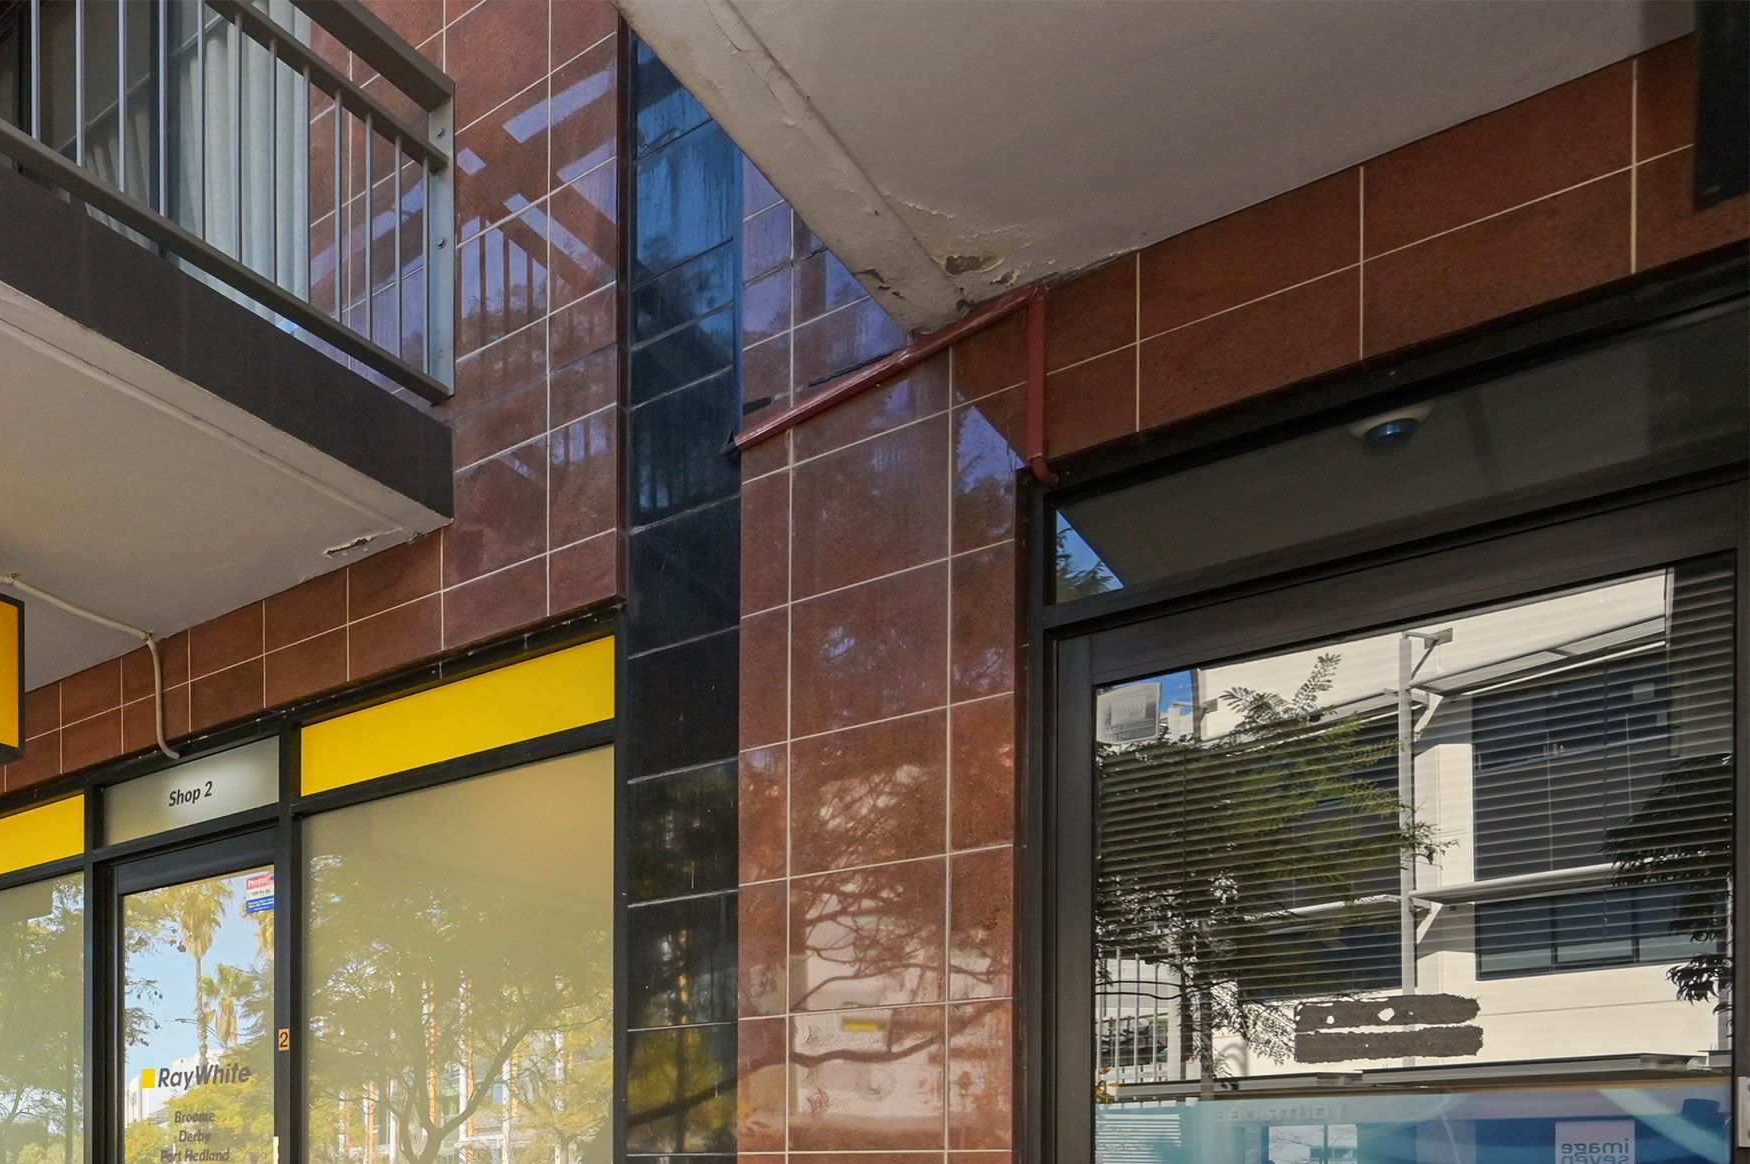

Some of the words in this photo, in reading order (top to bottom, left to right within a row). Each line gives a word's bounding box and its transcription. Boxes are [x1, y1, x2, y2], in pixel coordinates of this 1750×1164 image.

[168, 788, 201, 806] Shop
[204, 780, 214, 798] 2
[279, 1031, 288, 1048] 2
[174, 1111, 215, 1124] Broome
[179, 1130, 212, 1144] Derby
[161, 1149, 182, 1163] Port
[184, 1148, 230, 1163] Hedland
